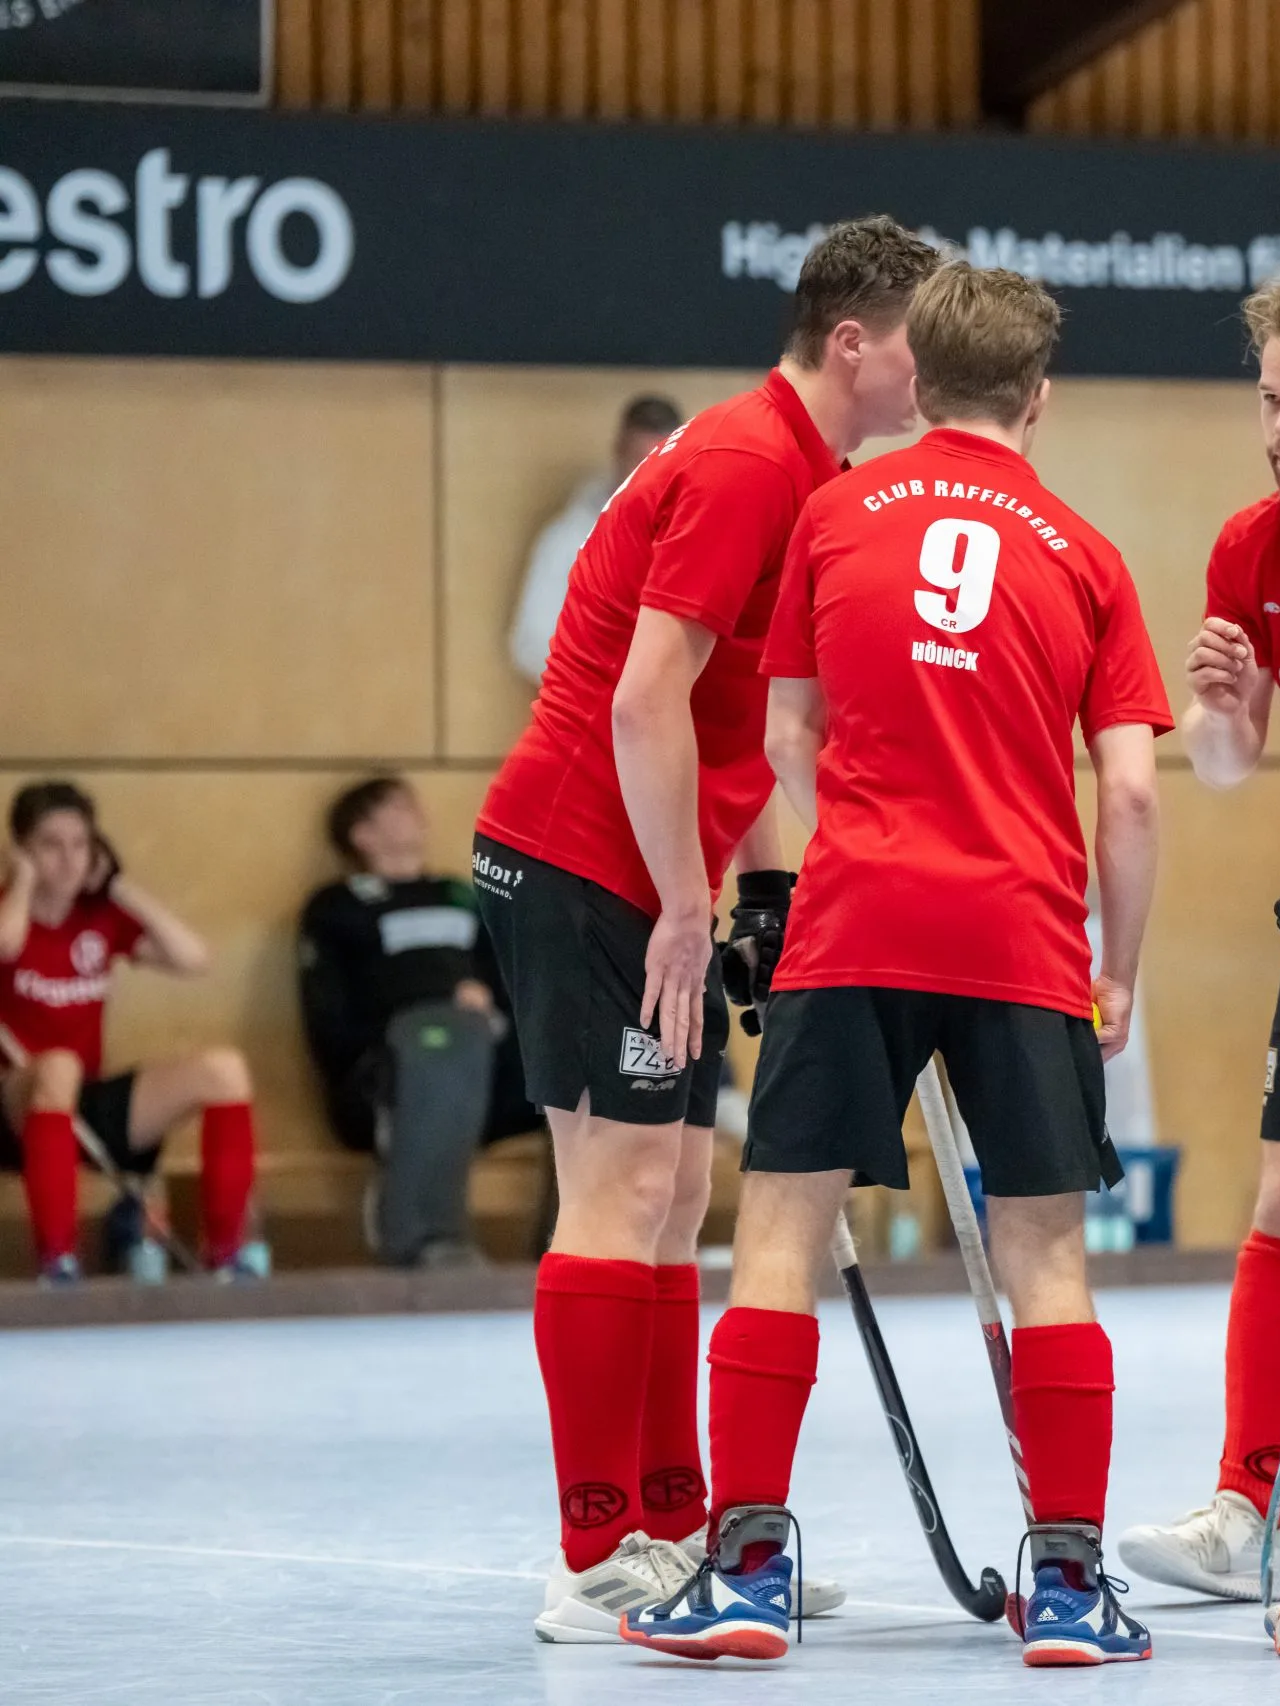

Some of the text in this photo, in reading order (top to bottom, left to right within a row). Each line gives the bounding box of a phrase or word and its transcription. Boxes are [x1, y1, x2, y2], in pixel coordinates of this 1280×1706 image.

[863, 479, 1069, 551] CLUB RAFFELBERG
[914, 518, 1000, 633] 9
[940, 618, 957, 629] CR
[911, 640, 979, 671] HÖINCK
